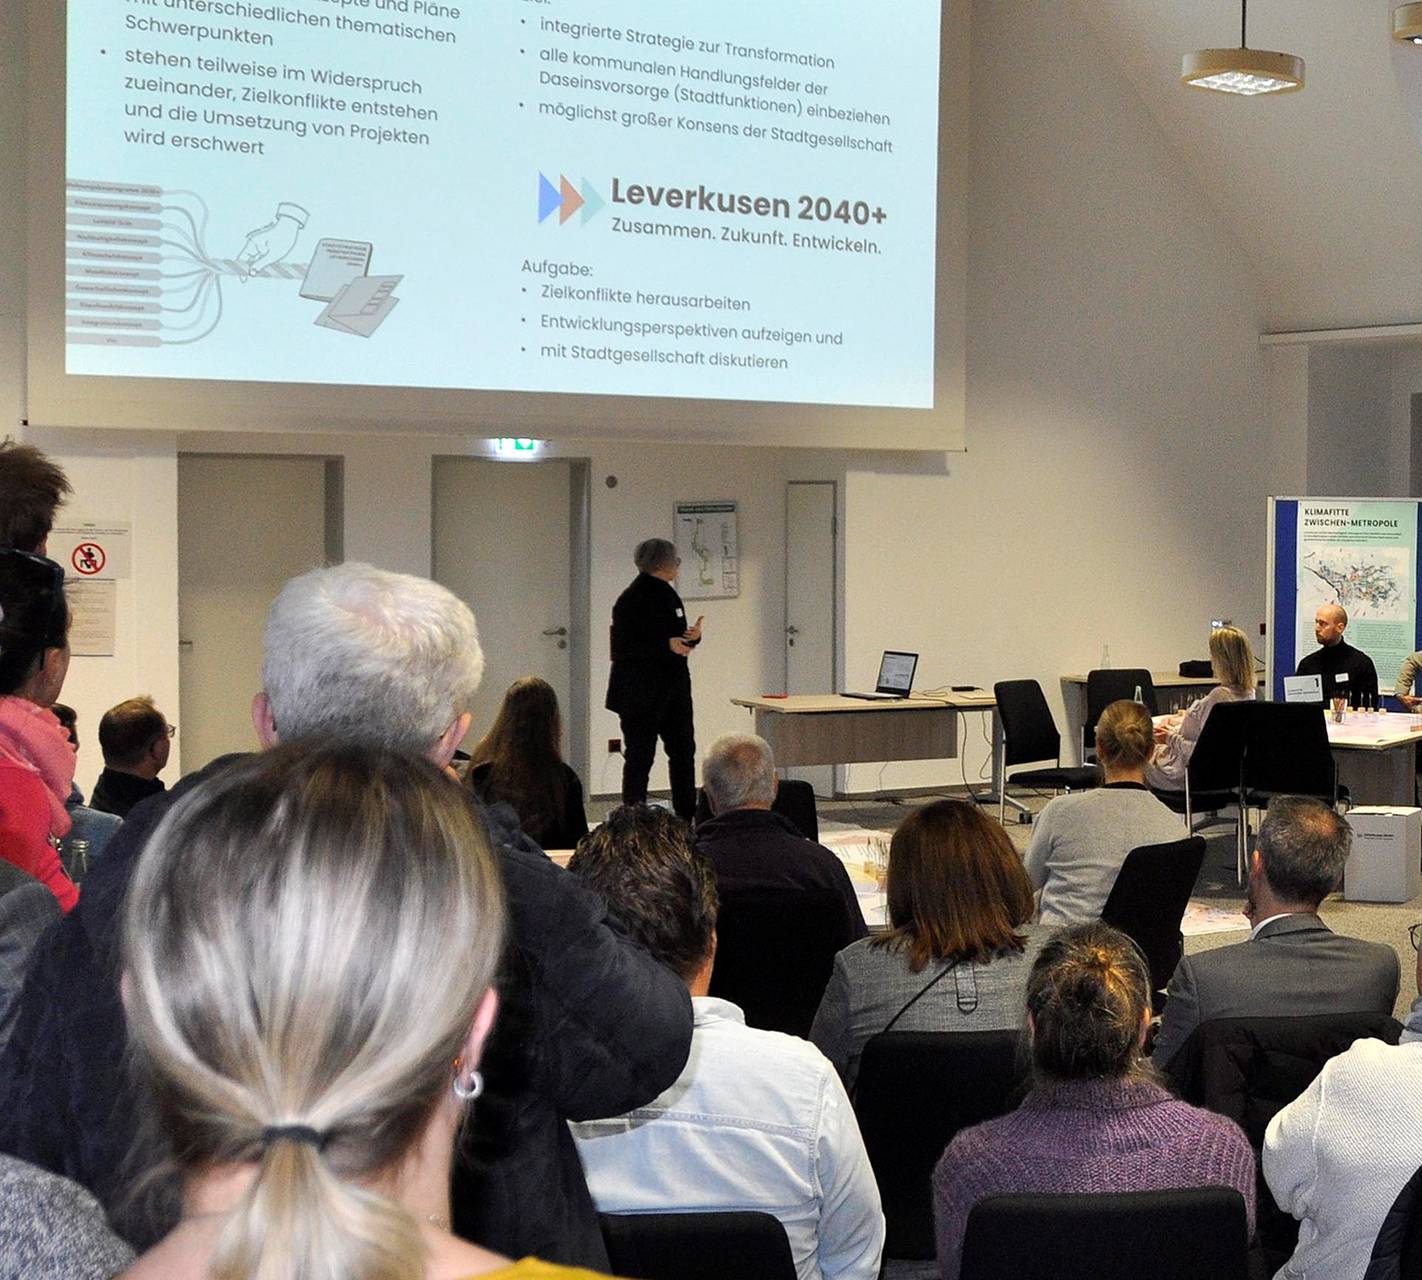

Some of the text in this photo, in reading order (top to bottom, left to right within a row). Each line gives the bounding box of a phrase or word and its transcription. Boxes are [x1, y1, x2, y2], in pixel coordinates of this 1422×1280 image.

[164, 0, 456, 43] unterschiedlichen thematischen
[376, 0, 408, 13] und
[413, 1, 461, 19] Pläne
[126, 14, 273, 47] Schwerpunkten
[540, 16, 835, 69] integrierte Strategie zur Transformation
[125, 48, 422, 94] stehen teilweise im Widerspruch
[540, 48, 828, 96] alle kommunalen Handlungsfelder der
[124, 76, 438, 121] zueinander, Zielkonflikte entstehen
[540, 71, 890, 125] Daseinsvorsorge (Stadtfunktionen) einbeziehen
[124, 129, 264, 155] wird erschwert
[125, 103, 430, 145] und die Umsetzung von Projekten
[539, 101, 892, 153] möglichst großer Konsens der Stadtgesellschaft
[612, 177, 887, 226] Leverkusen 2040+
[612, 217, 882, 255] Zusammen. Zukunft. Entwickeln.
[521, 259, 593, 278] Aufgabe:
[541, 284, 751, 311] Zielkonflikte herausarbeiten
[541, 314, 843, 346] Entwicklungsperspektiven aufzeigen und
[541, 343, 788, 369] mit Stadtgesellschaft diskutieren
[1304, 508, 1350, 516] KLIMAFITTE
[1304, 518, 1398, 528] ZWISCHEN-METROPOLE
